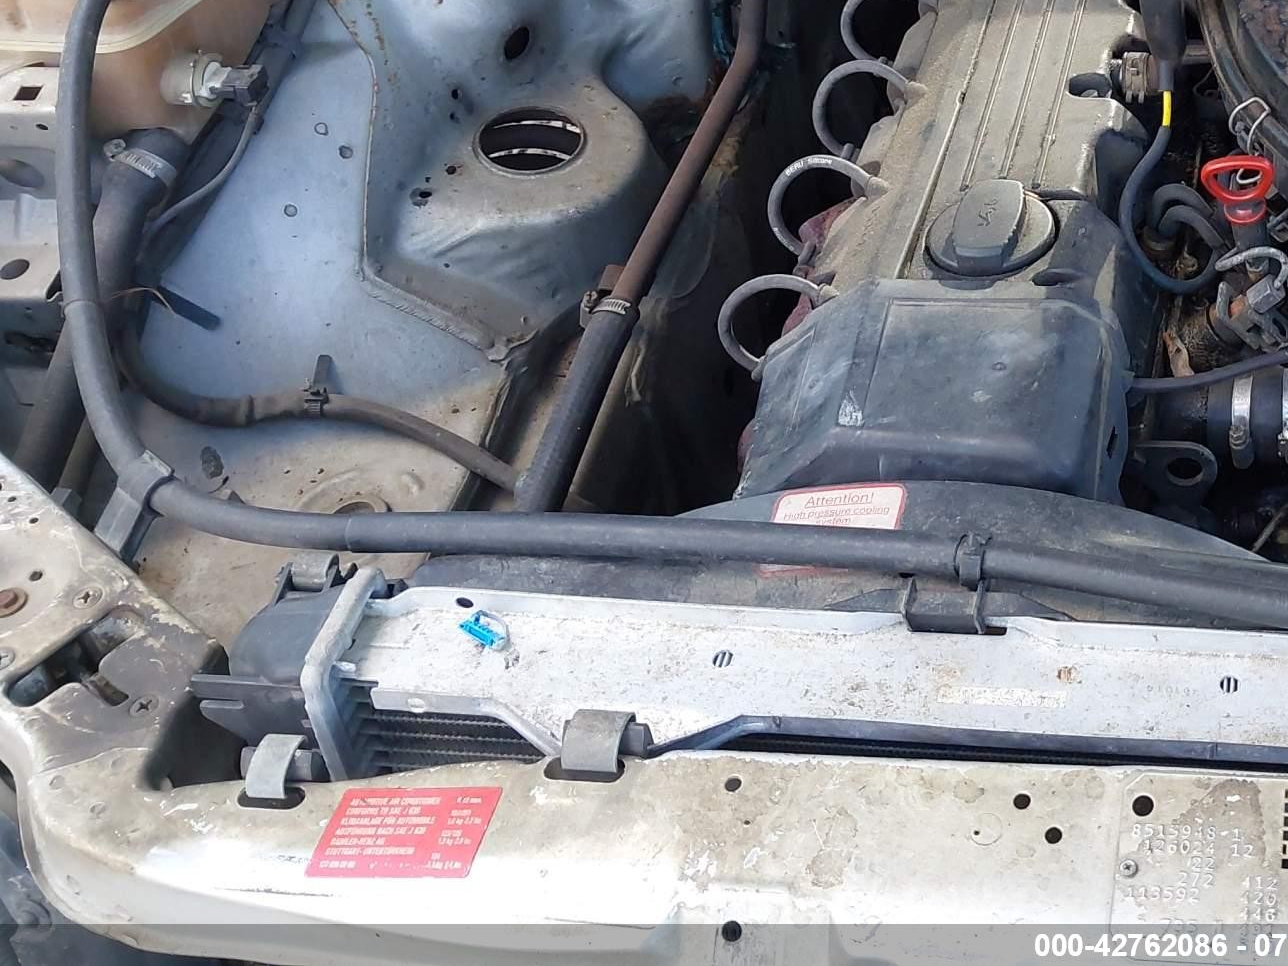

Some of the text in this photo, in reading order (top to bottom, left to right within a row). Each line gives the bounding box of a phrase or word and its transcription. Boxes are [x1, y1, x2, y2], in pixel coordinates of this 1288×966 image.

[804, 493, 874, 508] Attention!
[853, 506, 890, 515] cooling
[346, 807, 379, 815] CONFORMS
[1231, 843, 1256, 859] 12
[1177, 871, 1216, 888] 272
